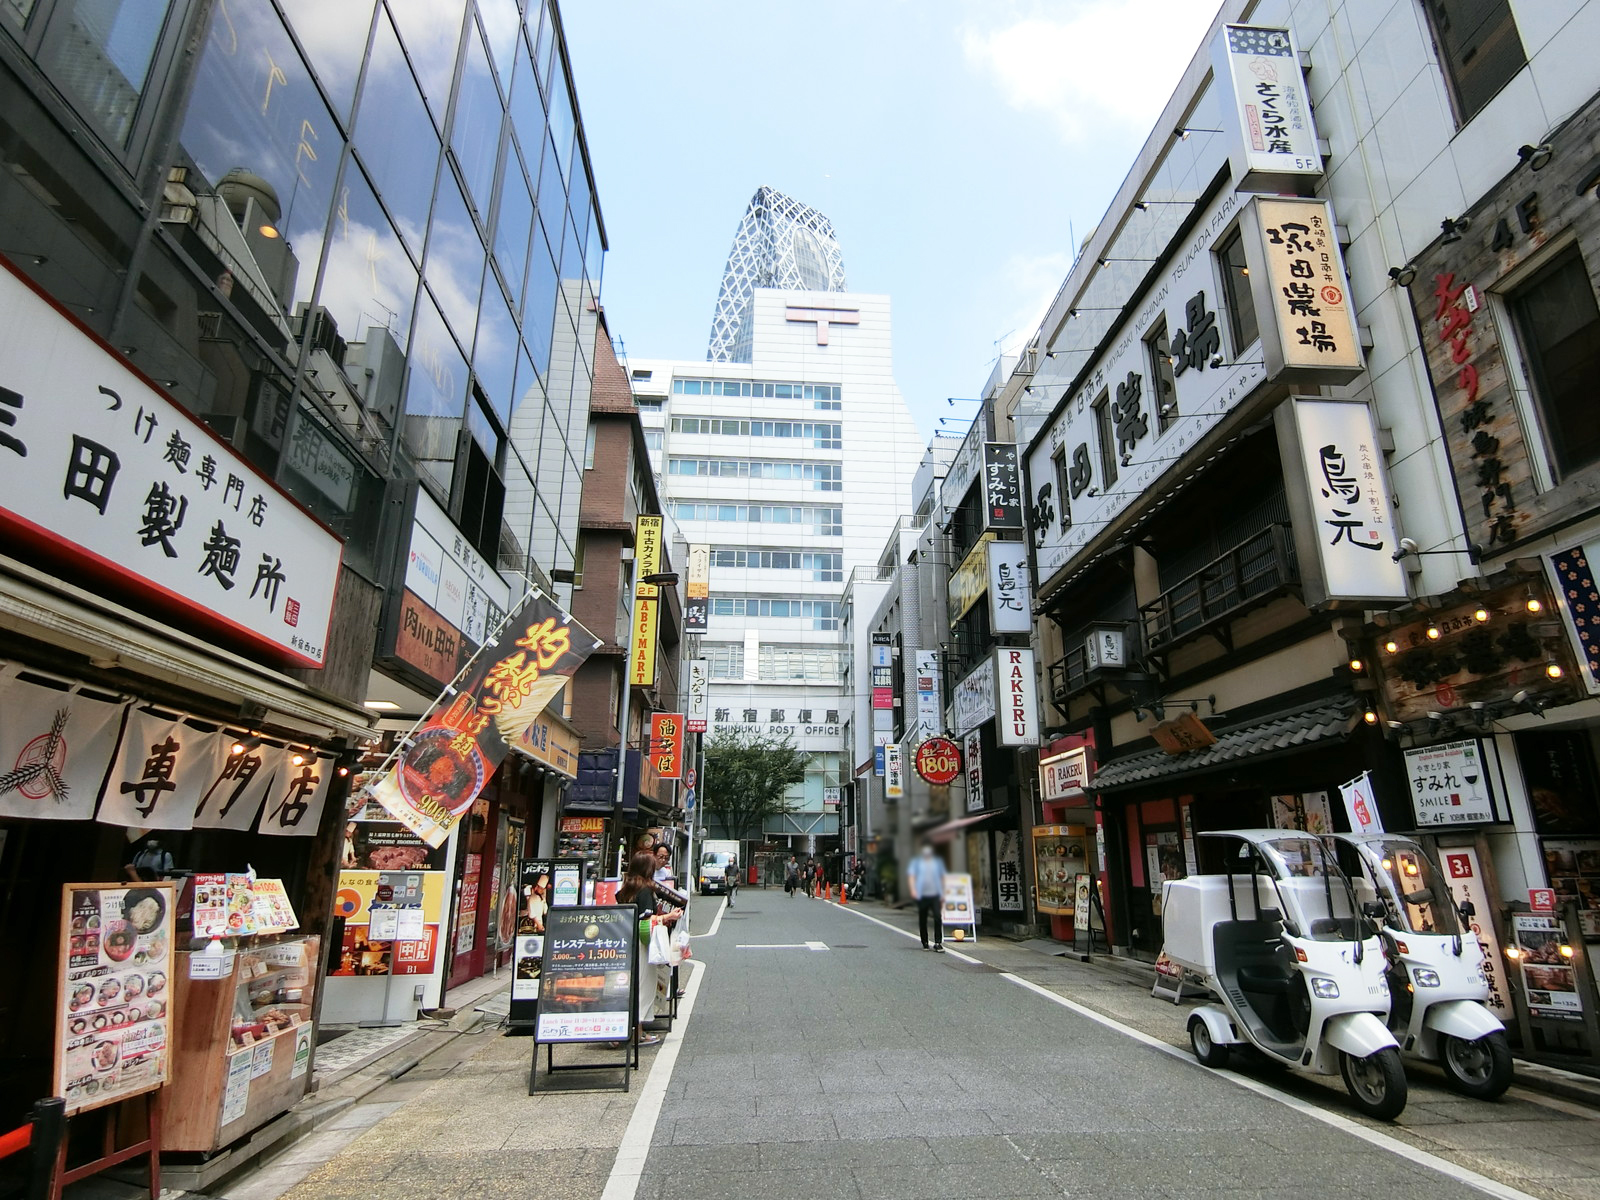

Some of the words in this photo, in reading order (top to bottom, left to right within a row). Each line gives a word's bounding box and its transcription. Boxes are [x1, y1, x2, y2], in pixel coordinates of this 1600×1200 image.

[1255, 82, 1293, 154] さくら水産
[1296, 158, 1312, 169] 5F
[1492, 191, 1538, 252] 4F
[1106, 331, 1134, 373] MIYAZAKI
[1136, 285, 1170, 336] NICHINAN
[1172, 228, 1212, 284] TSUKADA
[1211, 190, 1239, 233] FARM
[1266, 222, 1337, 353] 塚田農場
[98, 385, 268, 528] つけ麺専門店
[987, 462, 1008, 506] すみれ
[1005, 452, 1019, 507] やきとり家
[1319, 444, 1384, 550] 鳥元
[640, 518, 660, 527] 新宿
[453, 534, 485, 581] 西新ビル
[638, 586, 655, 595] 2F
[998, 563, 1023, 611] 鳥元
[403, 606, 456, 663] 肉バル田中
[1009, 651, 1026, 737] RAKERU
[715, 707, 840, 724] 新宿郵便局
[715, 724, 761, 734] SHINJUKU
[769, 725, 796, 735] POST
[804, 726, 840, 735] OFFICE
[922, 747, 953, 757] 生ビール
[919, 756, 959, 775] 180円
[1057, 762, 1083, 781] RAKERU
[1417, 761, 1451, 773] やきとり家
[120, 735, 320, 828] 専門店
[1413, 773, 1461, 793] すみれ
[1420, 796, 1450, 807] SMILE
[581, 818, 603, 831] SALE
[1433, 812, 1445, 823] 4F
[368, 837, 395, 845] Supreme
[1452, 859, 1470, 876] 3F
[998, 860, 1019, 902] 勝男
[553, 939, 628, 949] ヒレステーキセット
[588, 948, 627, 960] 1,500yen
[407, 965, 417, 974] B1
